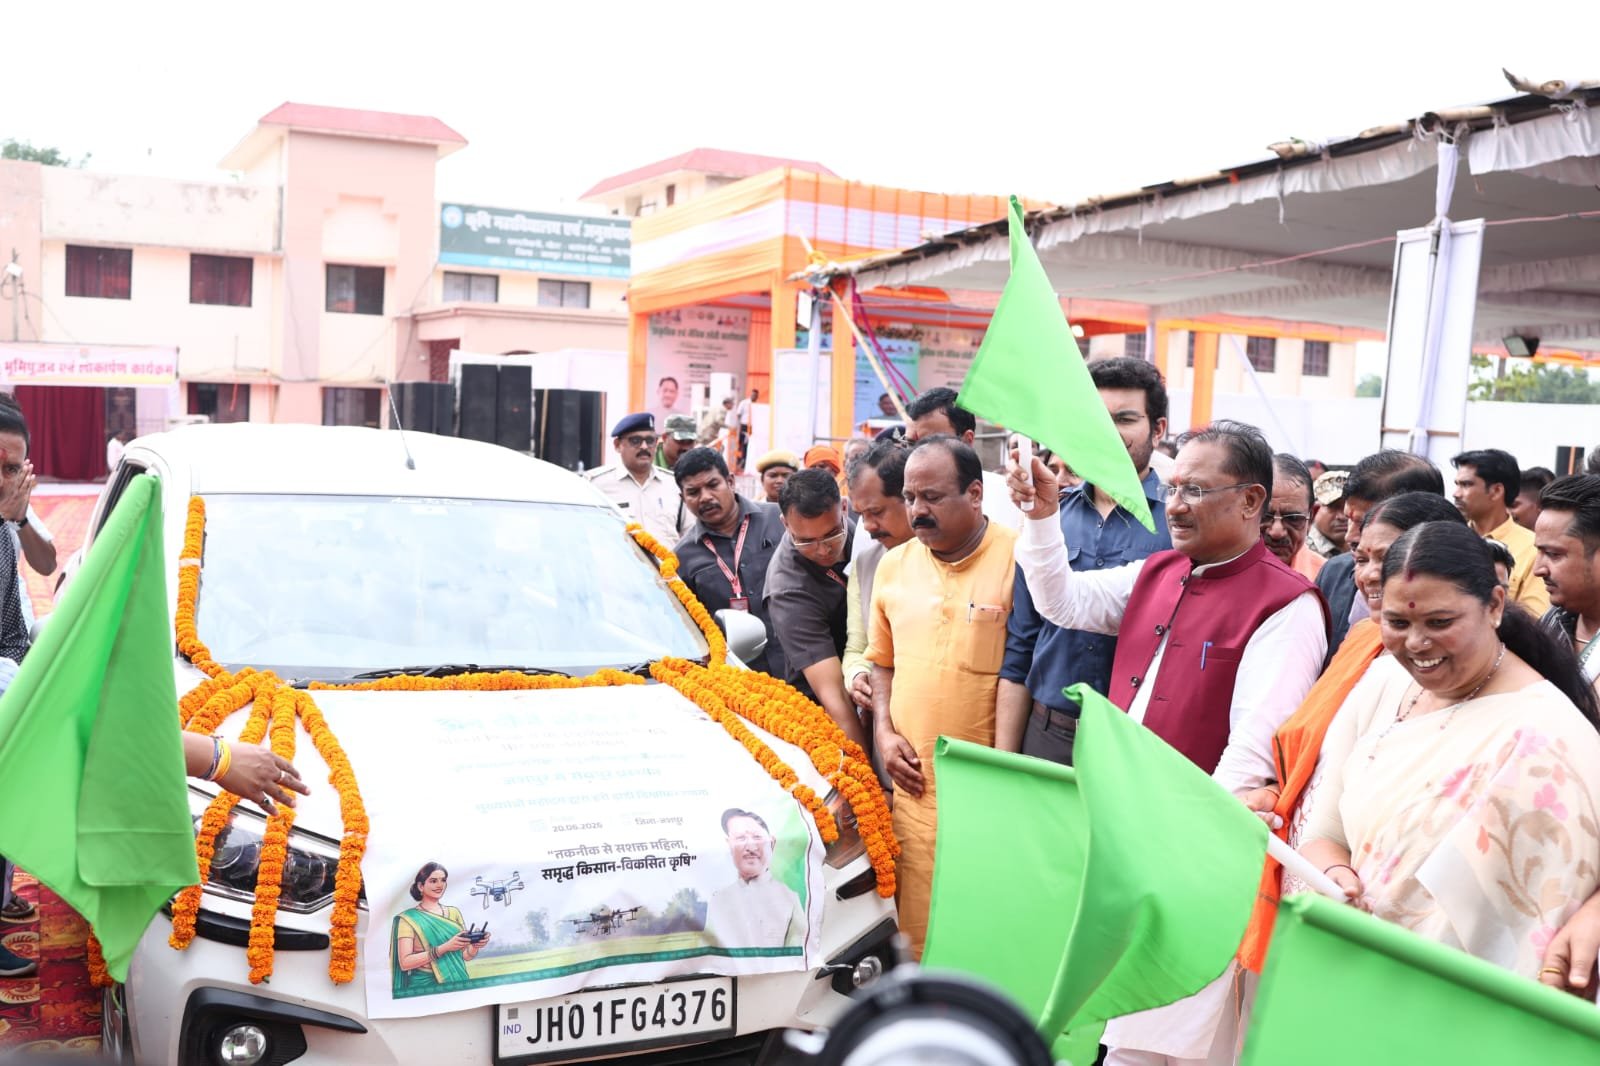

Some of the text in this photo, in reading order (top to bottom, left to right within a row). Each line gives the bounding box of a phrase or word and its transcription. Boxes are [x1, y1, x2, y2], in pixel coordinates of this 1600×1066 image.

[601, 842, 613, 855] से
[615, 840, 649, 854] सशक्त
[650, 837, 689, 852] महिला,
[541, 864, 575, 883] समृद्ध
[576, 854, 666, 877] किसान-विकसित
[526, 987, 727, 1045] JH01FG4376
[503, 1023, 522, 1036] IND
